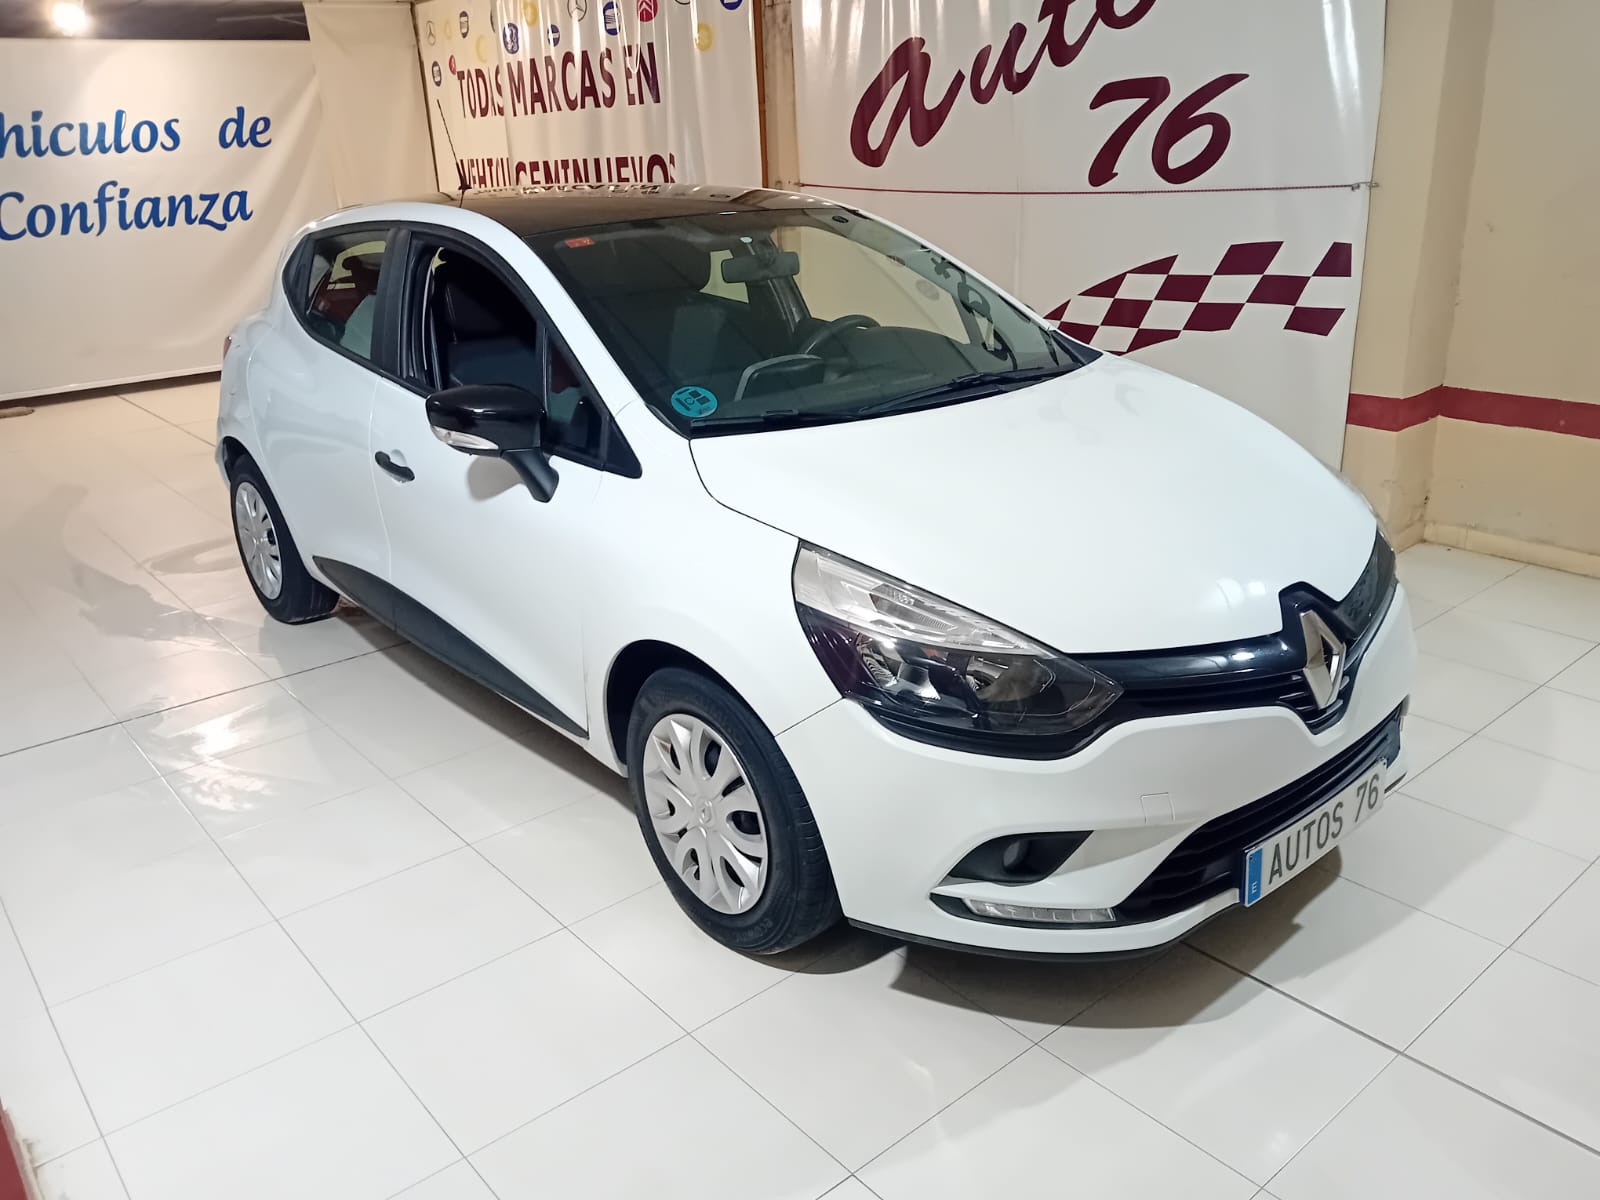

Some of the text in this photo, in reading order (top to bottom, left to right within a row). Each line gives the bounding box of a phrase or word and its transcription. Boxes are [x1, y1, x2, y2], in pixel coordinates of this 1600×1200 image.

[507, 47, 616, 117] MARCAS
[623, 42, 661, 106] EN
[218, 106, 272, 149] de
[1088, 73, 1249, 187] 76
[0, 180, 253, 241] Confianza
[1268, 773, 1380, 885] AUTOS 76
